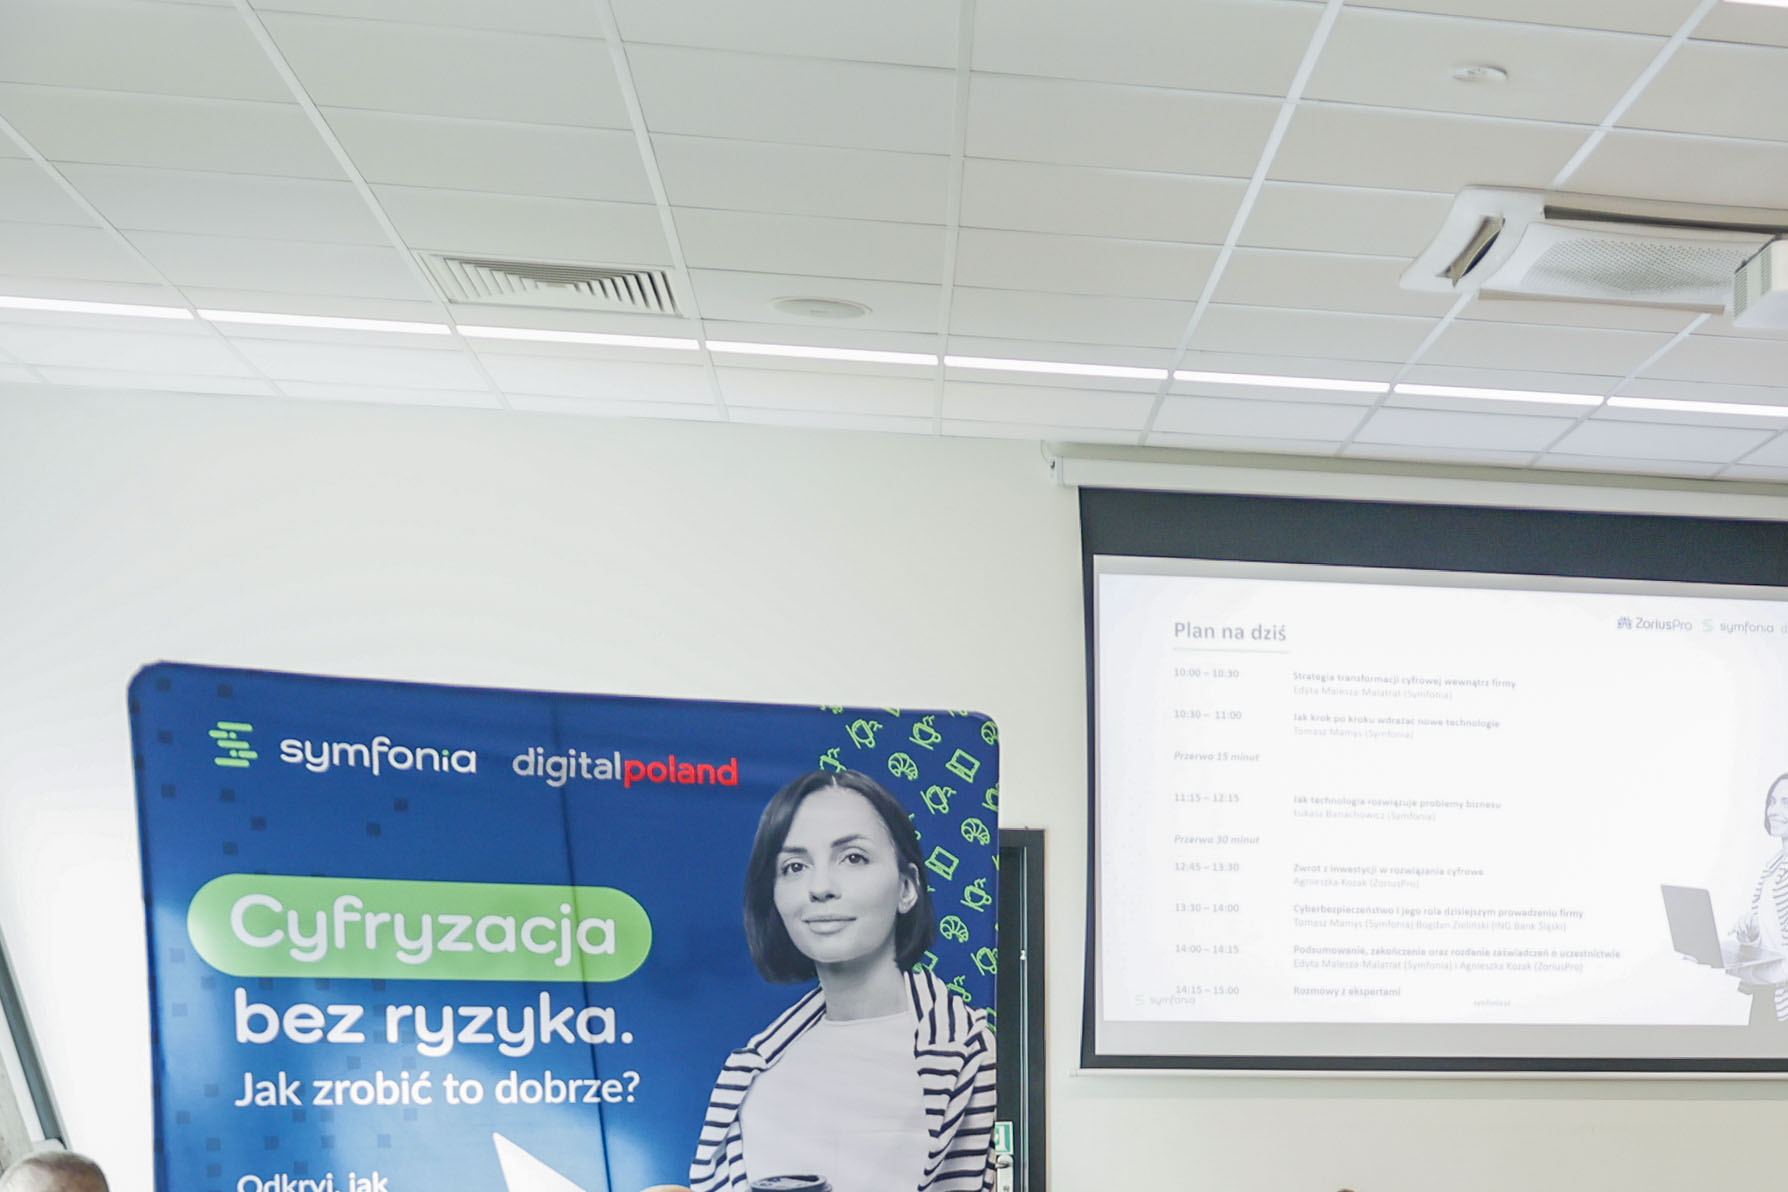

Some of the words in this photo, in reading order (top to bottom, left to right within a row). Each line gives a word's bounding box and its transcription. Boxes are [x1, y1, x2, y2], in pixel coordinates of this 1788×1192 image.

[1174, 620, 1216, 640] Plan
[1221, 625, 1245, 641] na
[1250, 623, 1287, 642] dziś
[1635, 616, 1693, 633] ZoriusPro
[1719, 620, 1775, 635] symfonia
[1173, 667, 1201, 679] 10:00
[1212, 667, 1240, 679] 10:30
[1292, 671, 1335, 684] Strategia
[1337, 673, 1400, 687] transformacji
[1401, 675, 1442, 687] cyfrowej
[1444, 677, 1489, 689] wewnątrz
[1491, 677, 1517, 691] firmy
[1173, 709, 1201, 720] 10:30
[1215, 709, 1242, 721] 11:00
[1293, 712, 1308, 723] Jak
[1310, 713, 1331, 723] krok
[1347, 714, 1376, 725] kroku
[1417, 717, 1444, 727] nowe
[1445, 716, 1501, 730] technologie
[280, 734, 477, 777] symfonia
[1173, 750, 1214, 762] Przerwa
[1216, 751, 1229, 761] 15
[1230, 751, 1261, 762] minut
[512, 747, 740, 789] digitalpoland
[1174, 792, 1201, 804] 11:15
[1212, 793, 1240, 804] 12:15
[1419, 799, 1464, 813] problemy
[1465, 801, 1502, 811] biznesu
[1173, 833, 1214, 845] Przerwa
[1216, 834, 1230, 845] 30
[1230, 834, 1261, 845] minut
[1175, 861, 1201, 872] 12:45
[1212, 861, 1240, 872] 13:30
[1293, 863, 1321, 873] Zwrot
[1330, 864, 1378, 877] inwestycji
[1390, 866, 1445, 878] rozwiązania
[1446, 867, 1485, 879] cyfrowe
[1175, 903, 1202, 913] 13:30
[1212, 903, 1240, 913] 14:00
[1292, 903, 1394, 917] Cyberbezpieczeństwo
[1401, 907, 1421, 918] jego
[1443, 907, 1497, 920] dzisiejszym
[1498, 907, 1558, 920] prowadzeniu
[1559, 908, 1584, 921] firmy
[230, 893, 618, 967] Cyfryzacja
[1175, 943, 1202, 954] 14:00
[1212, 944, 1240, 955] 14:15
[1293, 944, 1370, 957] Podsumowanie,
[1370, 945, 1427, 957] zakończenie
[1176, 985, 1203, 995] 14:15
[1212, 985, 1240, 995] 15:00
[1293, 985, 1341, 998] Rozmowy
[1348, 985, 1401, 999] ekspertami
[234, 987, 366, 1045] bez
[385, 990, 635, 1059] ryzyka.
[234, 1071, 302, 1109] Jak
[313, 1070, 432, 1107] zrobić
[442, 1073, 485, 1107] to
[494, 1069, 641, 1107] dobrze?
